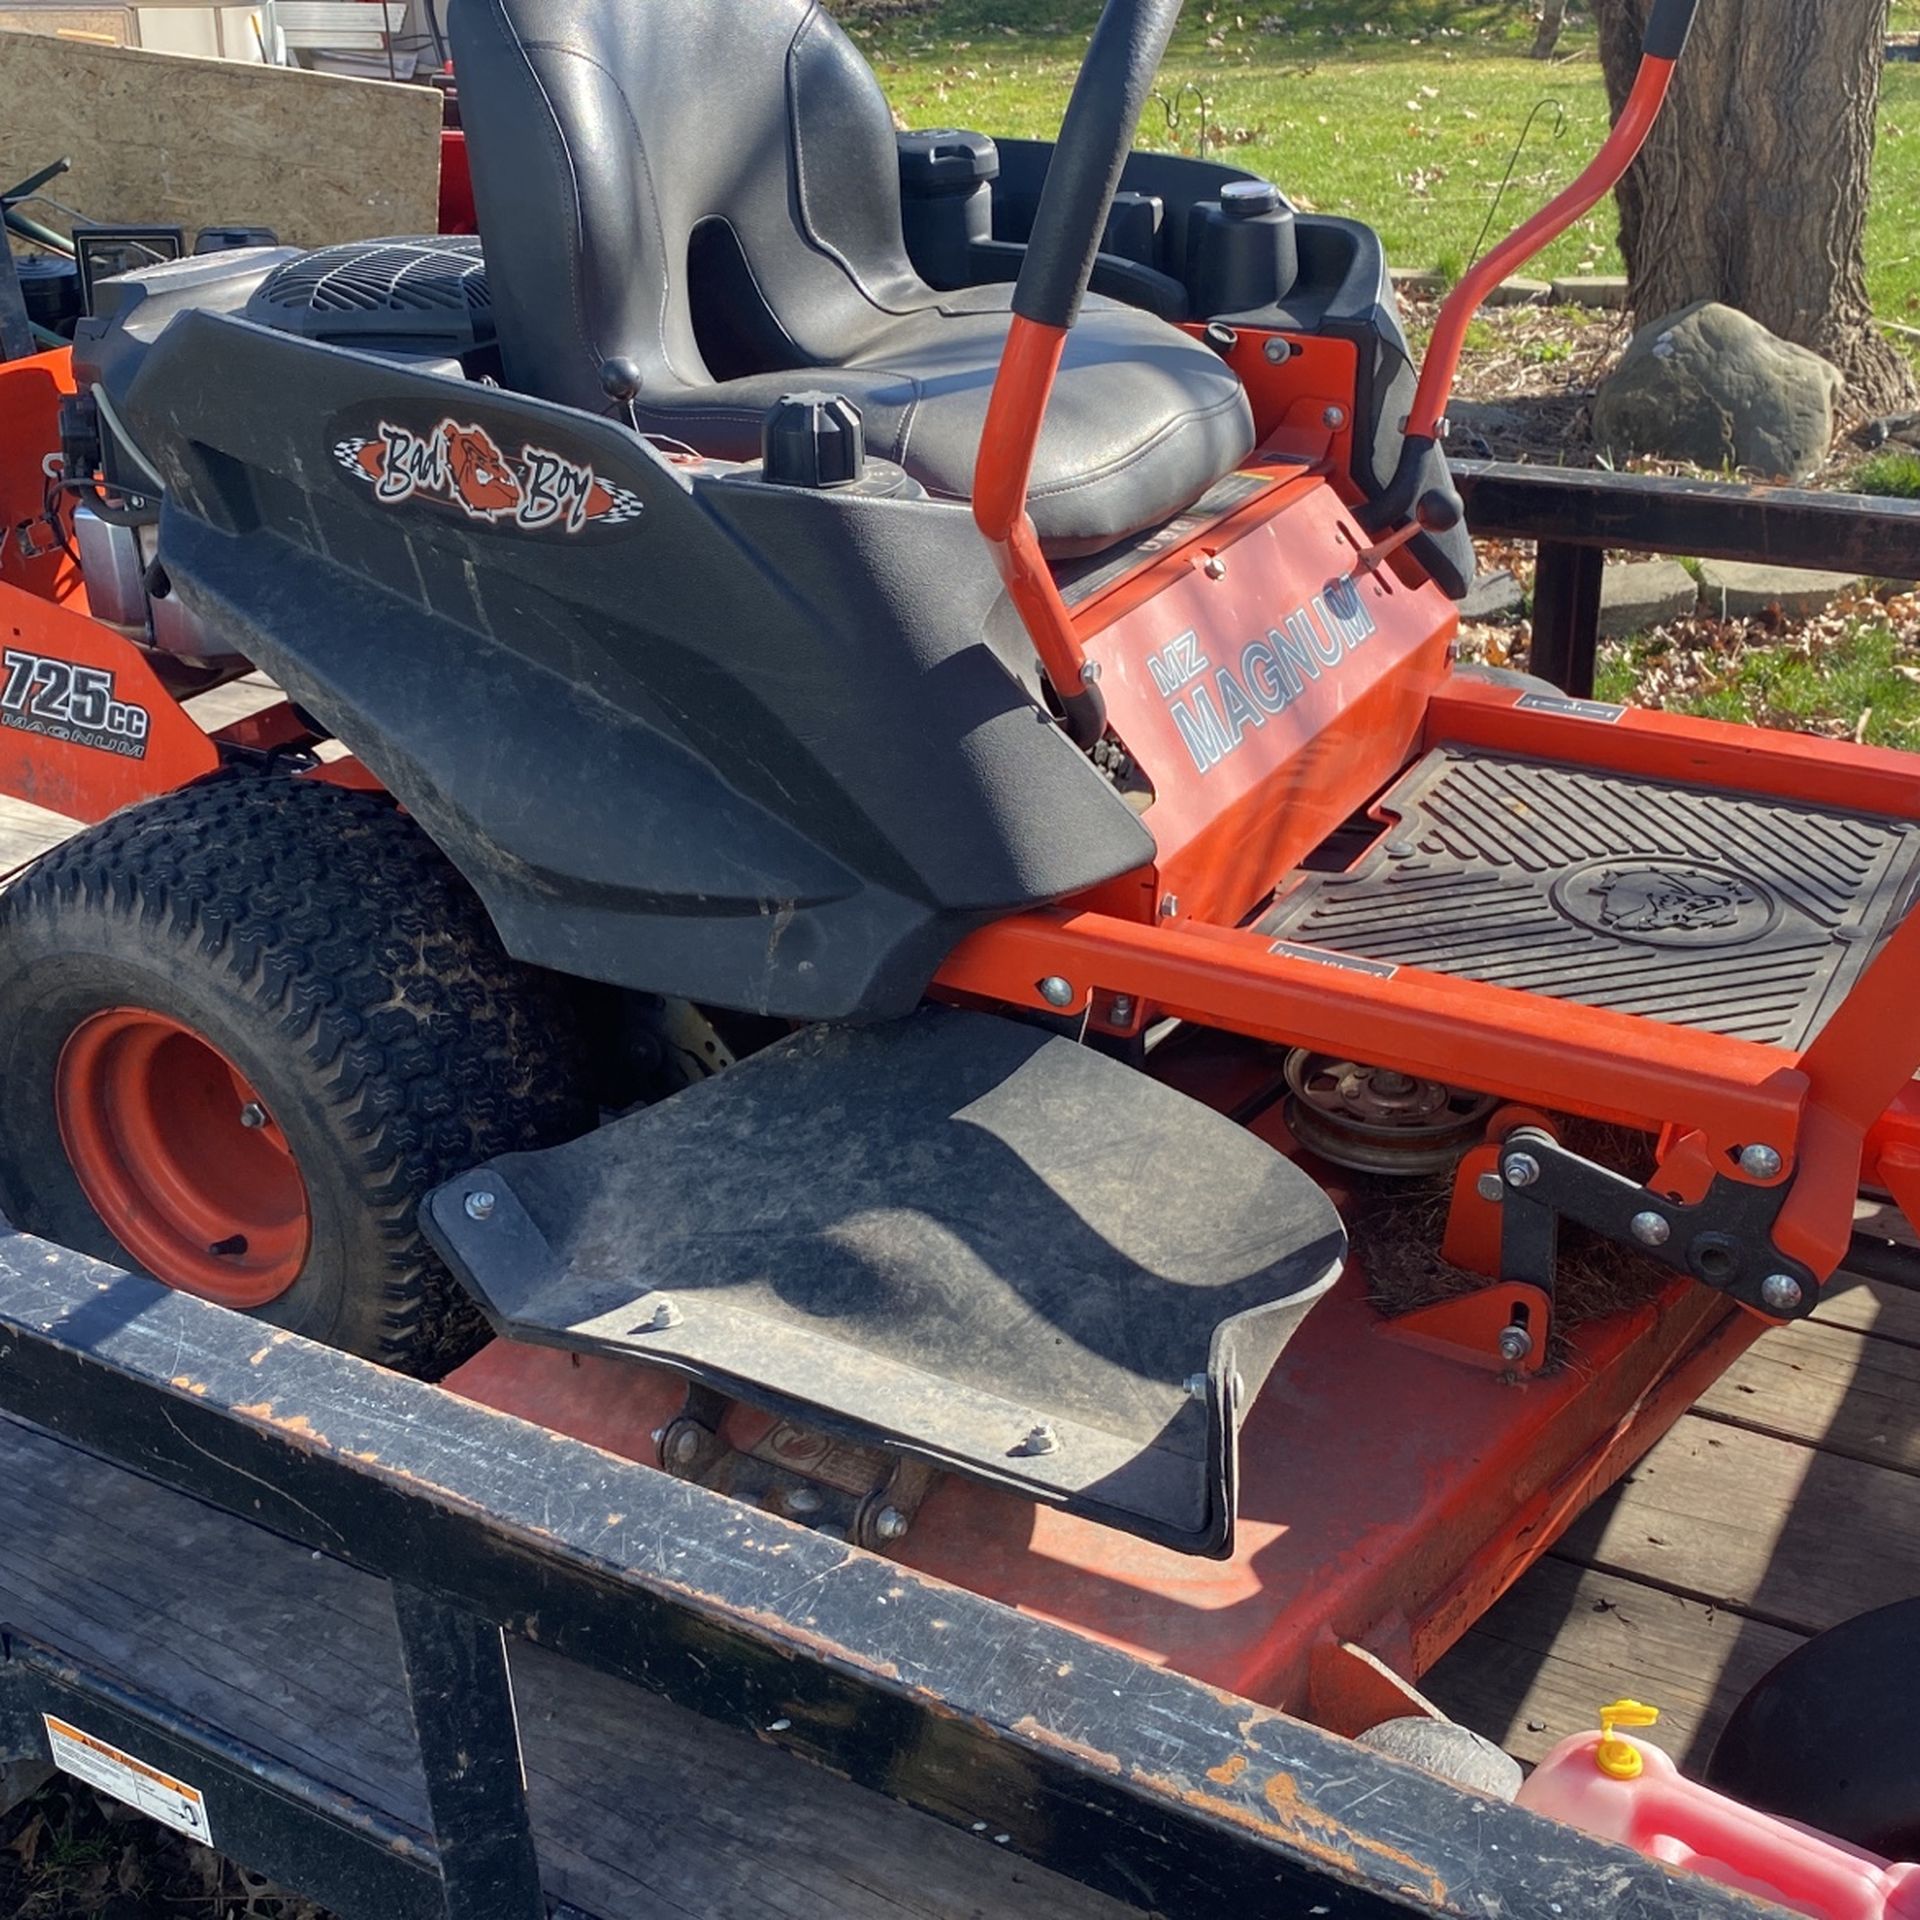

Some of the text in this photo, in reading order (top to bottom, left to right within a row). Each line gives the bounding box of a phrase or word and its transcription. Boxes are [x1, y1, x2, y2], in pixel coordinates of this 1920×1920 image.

[376, 421, 594, 533] Bad Boy
[1147, 630, 1209, 696] MZ
[1170, 573, 1376, 772] MAGNUM
[1, 713, 145, 758] MAGNUM
